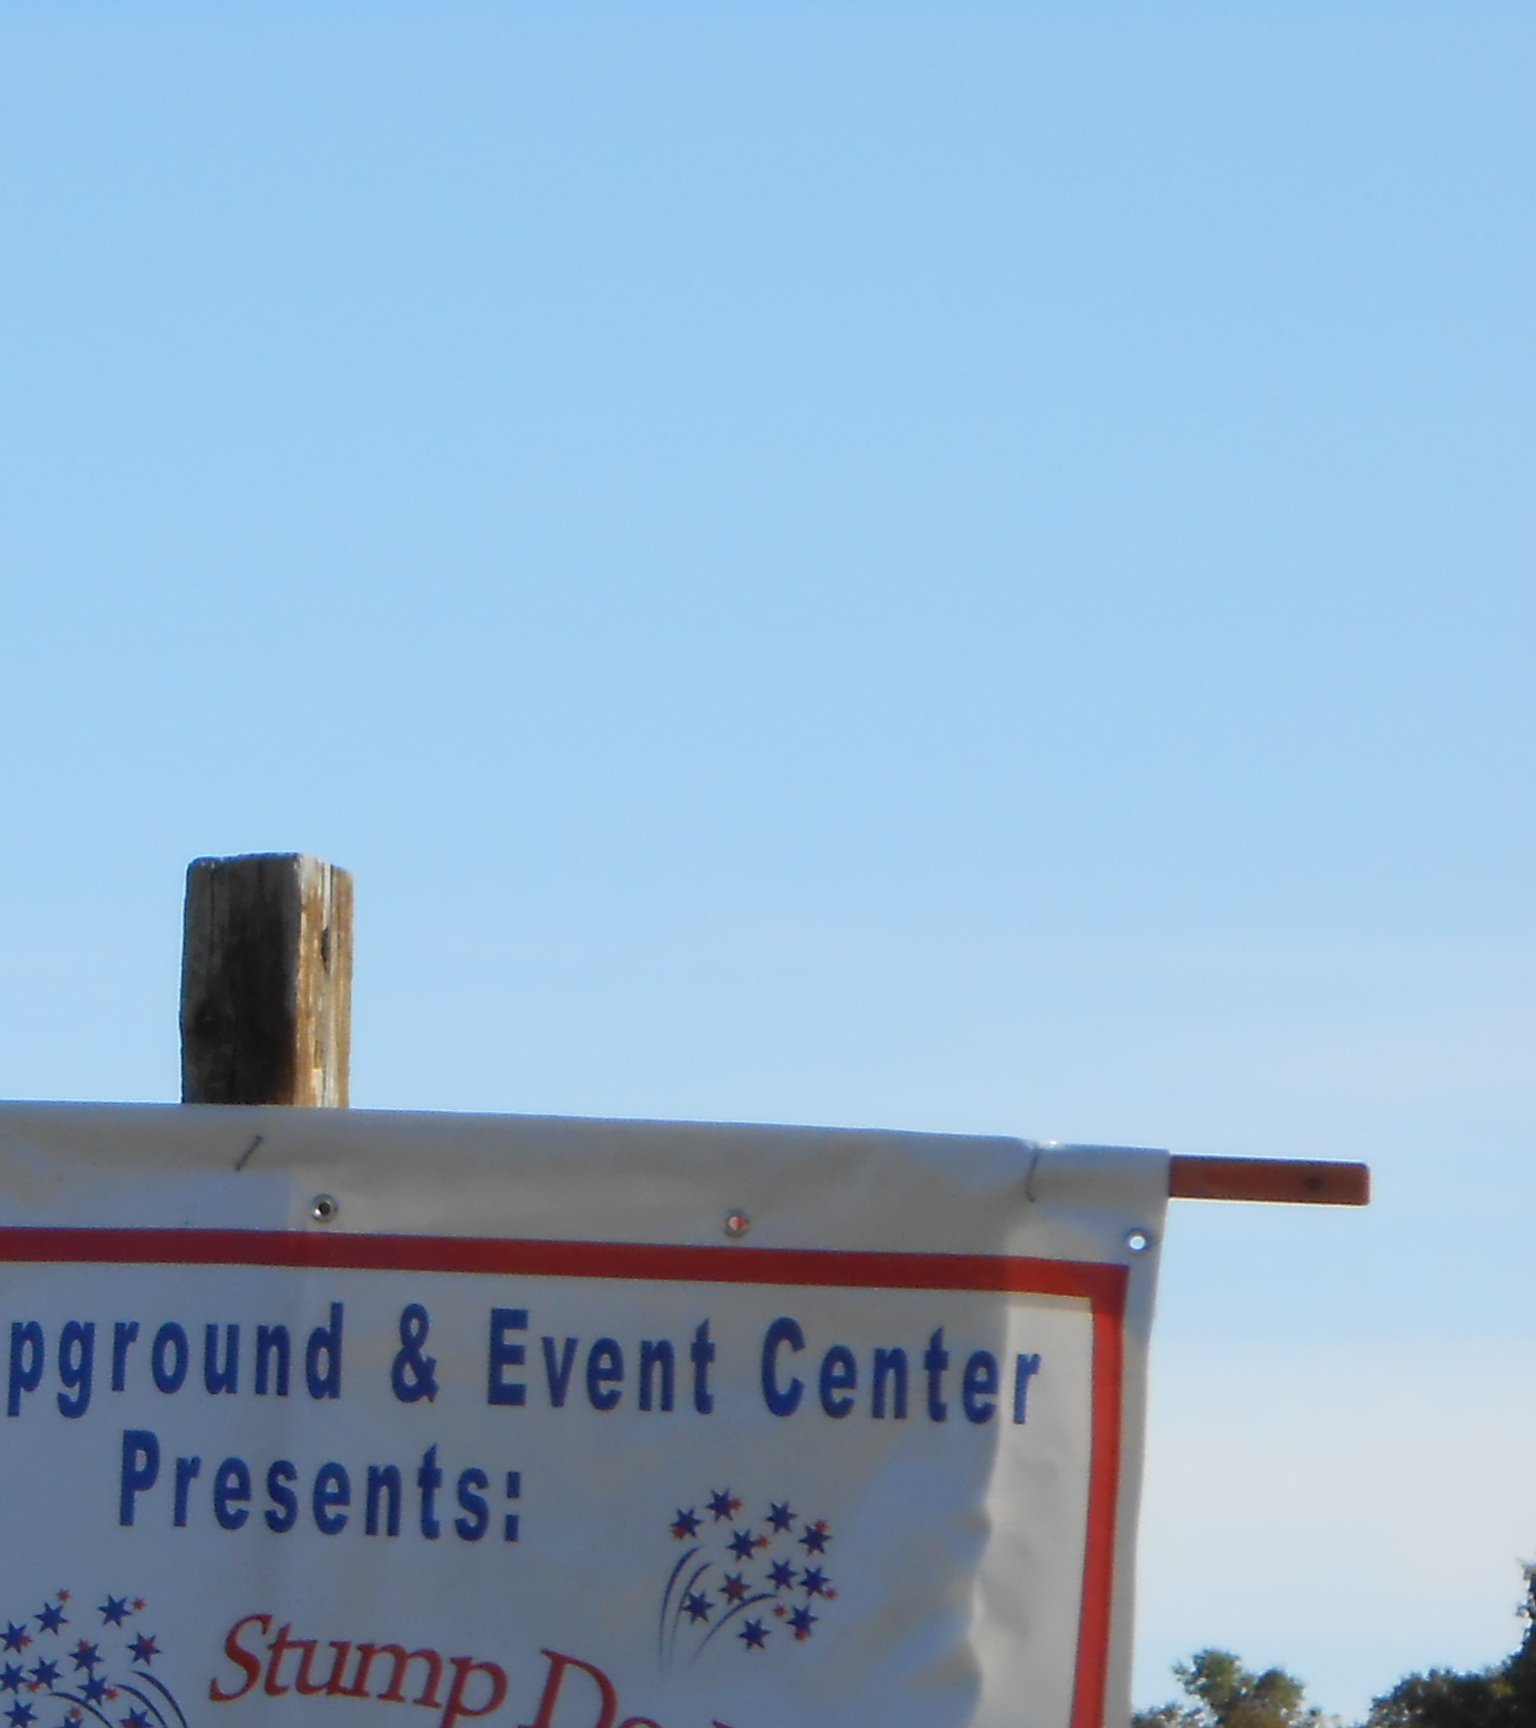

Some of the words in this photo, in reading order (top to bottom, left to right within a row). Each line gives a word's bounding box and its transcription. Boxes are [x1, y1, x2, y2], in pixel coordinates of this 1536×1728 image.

[391, 1303, 439, 1404] &
[487, 1307, 716, 1415] Event
[761, 1316, 1042, 1425] Center
[119, 1428, 522, 1543] Presents:
